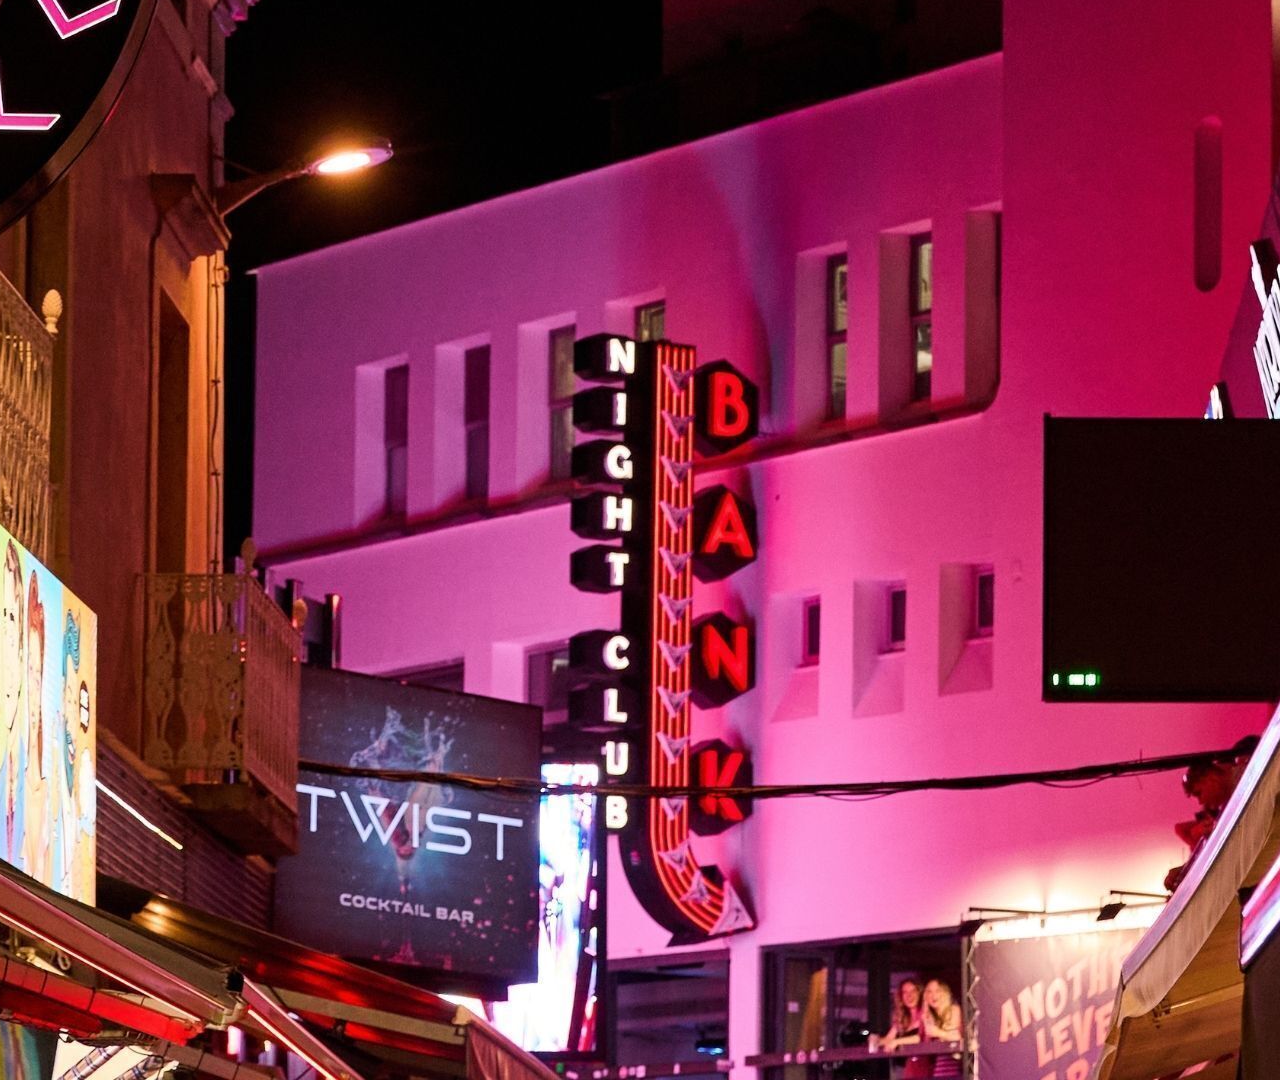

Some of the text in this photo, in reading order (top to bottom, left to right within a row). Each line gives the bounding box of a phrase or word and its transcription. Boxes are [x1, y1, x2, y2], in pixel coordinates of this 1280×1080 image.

[602, 338, 636, 829] NIGHT CLUB
[699, 371, 755, 822] BANK
[295, 783, 523, 861] TWIST
[339, 893, 474, 924] COCKTAIL BAR
[1036, 999, 1116, 1068] LEVE
